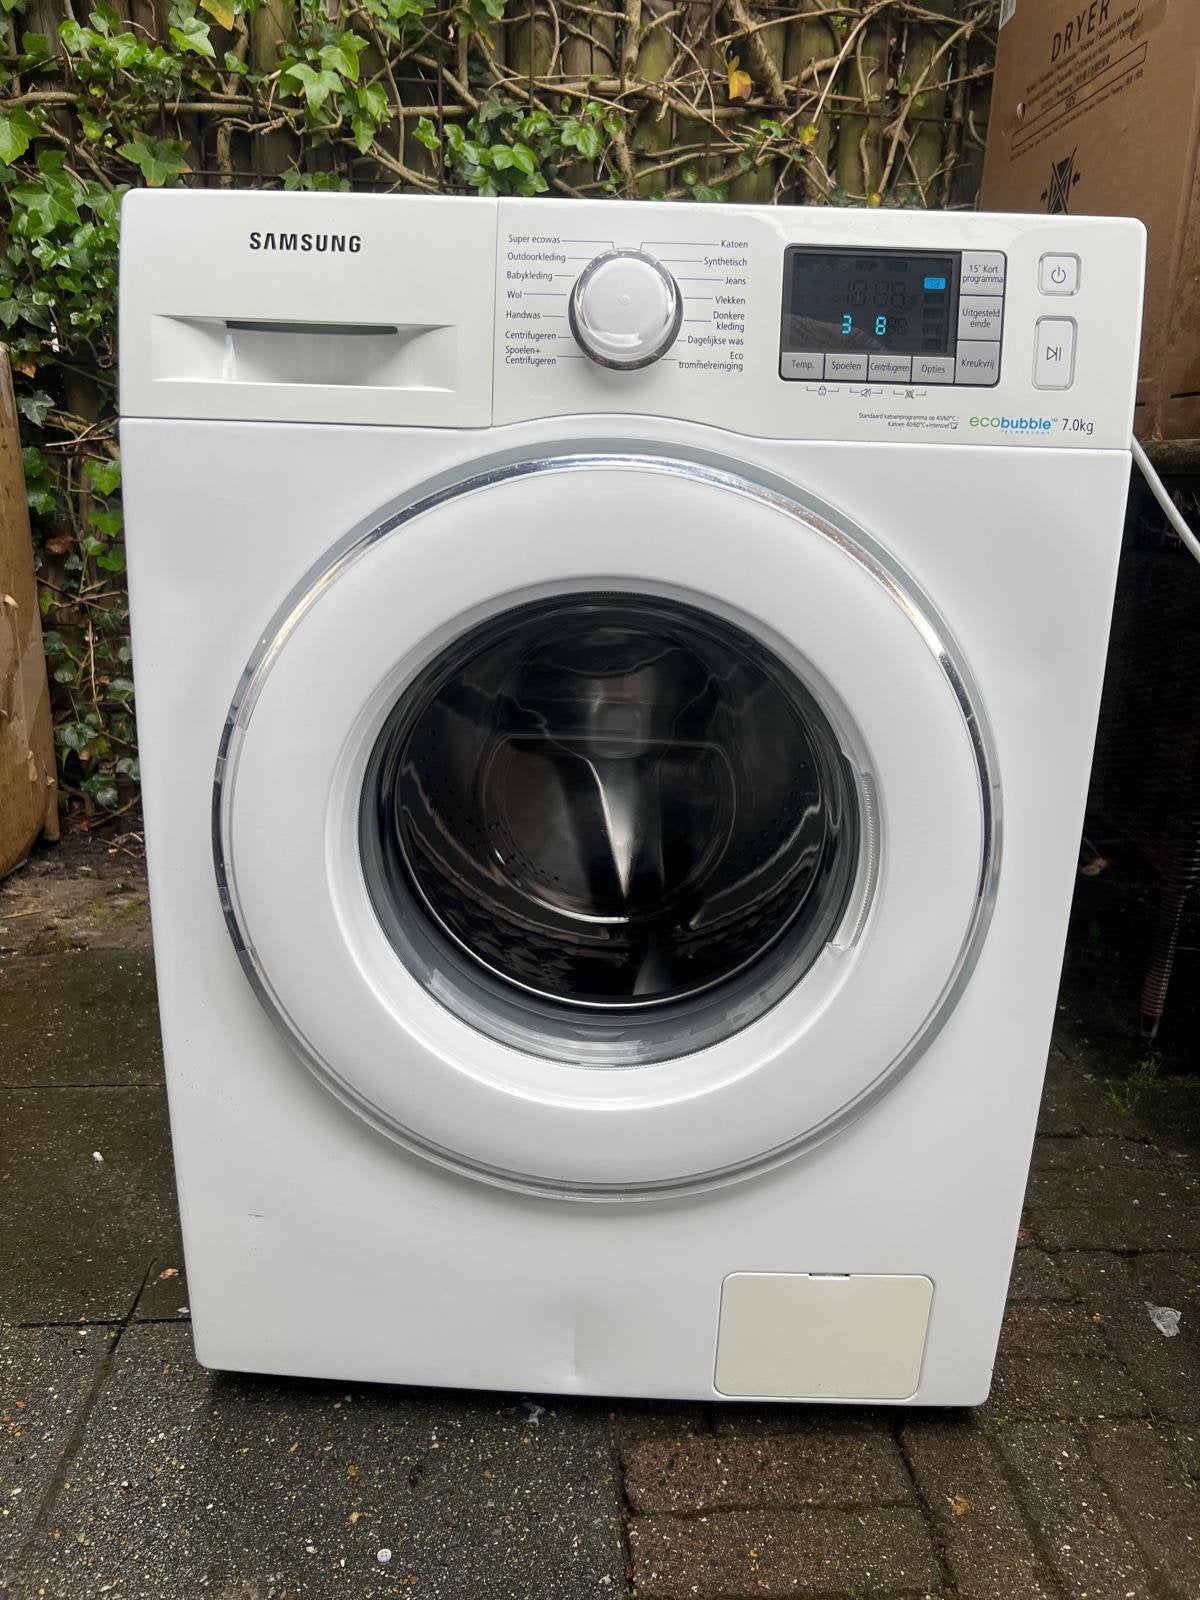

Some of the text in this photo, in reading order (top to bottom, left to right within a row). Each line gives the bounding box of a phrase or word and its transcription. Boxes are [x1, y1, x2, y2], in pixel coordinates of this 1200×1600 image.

[1051, 0, 1110, 62] DRYER
[249, 232, 361, 253] SAMSUNG
[508, 234, 561, 244] Super ecowas
[721, 240, 748, 248] Katoen
[507, 252, 566, 263] Outdoorkleding
[704, 257, 747, 267] Synthetisch
[983, 265, 999, 274] Kort
[506, 270, 553, 282] Babykleding
[725, 276, 746, 285] Jeans
[962, 275, 1004, 284] programma
[507, 290, 522, 298] Wol
[715, 296, 746, 304] Vlekken
[506, 310, 541, 319] Handwas
[713, 311, 745, 320] Donkere
[962, 308, 1000, 318] Uitgesteld
[716, 322, 745, 332] kleding
[841, 315, 852, 335] 3
[875, 316, 887, 336] 8
[970, 319, 991, 328] einde
[505, 331, 557, 342] Centrifugeren
[687, 336, 727, 346] Dagelijkse
[730, 352, 744, 360] Eco
[505, 356, 557, 367] Centrifugeren
[678, 361, 744, 371] trommelreiniging
[791, 360, 815, 369] Temp.
[831, 361, 861, 371] Spoelen
[961, 359, 995, 370] Kreukvrij
[870, 363, 910, 373] Centrifugeren
[921, 364, 946, 374] Opties
[1062, 418, 1094, 435] 7.0kg
